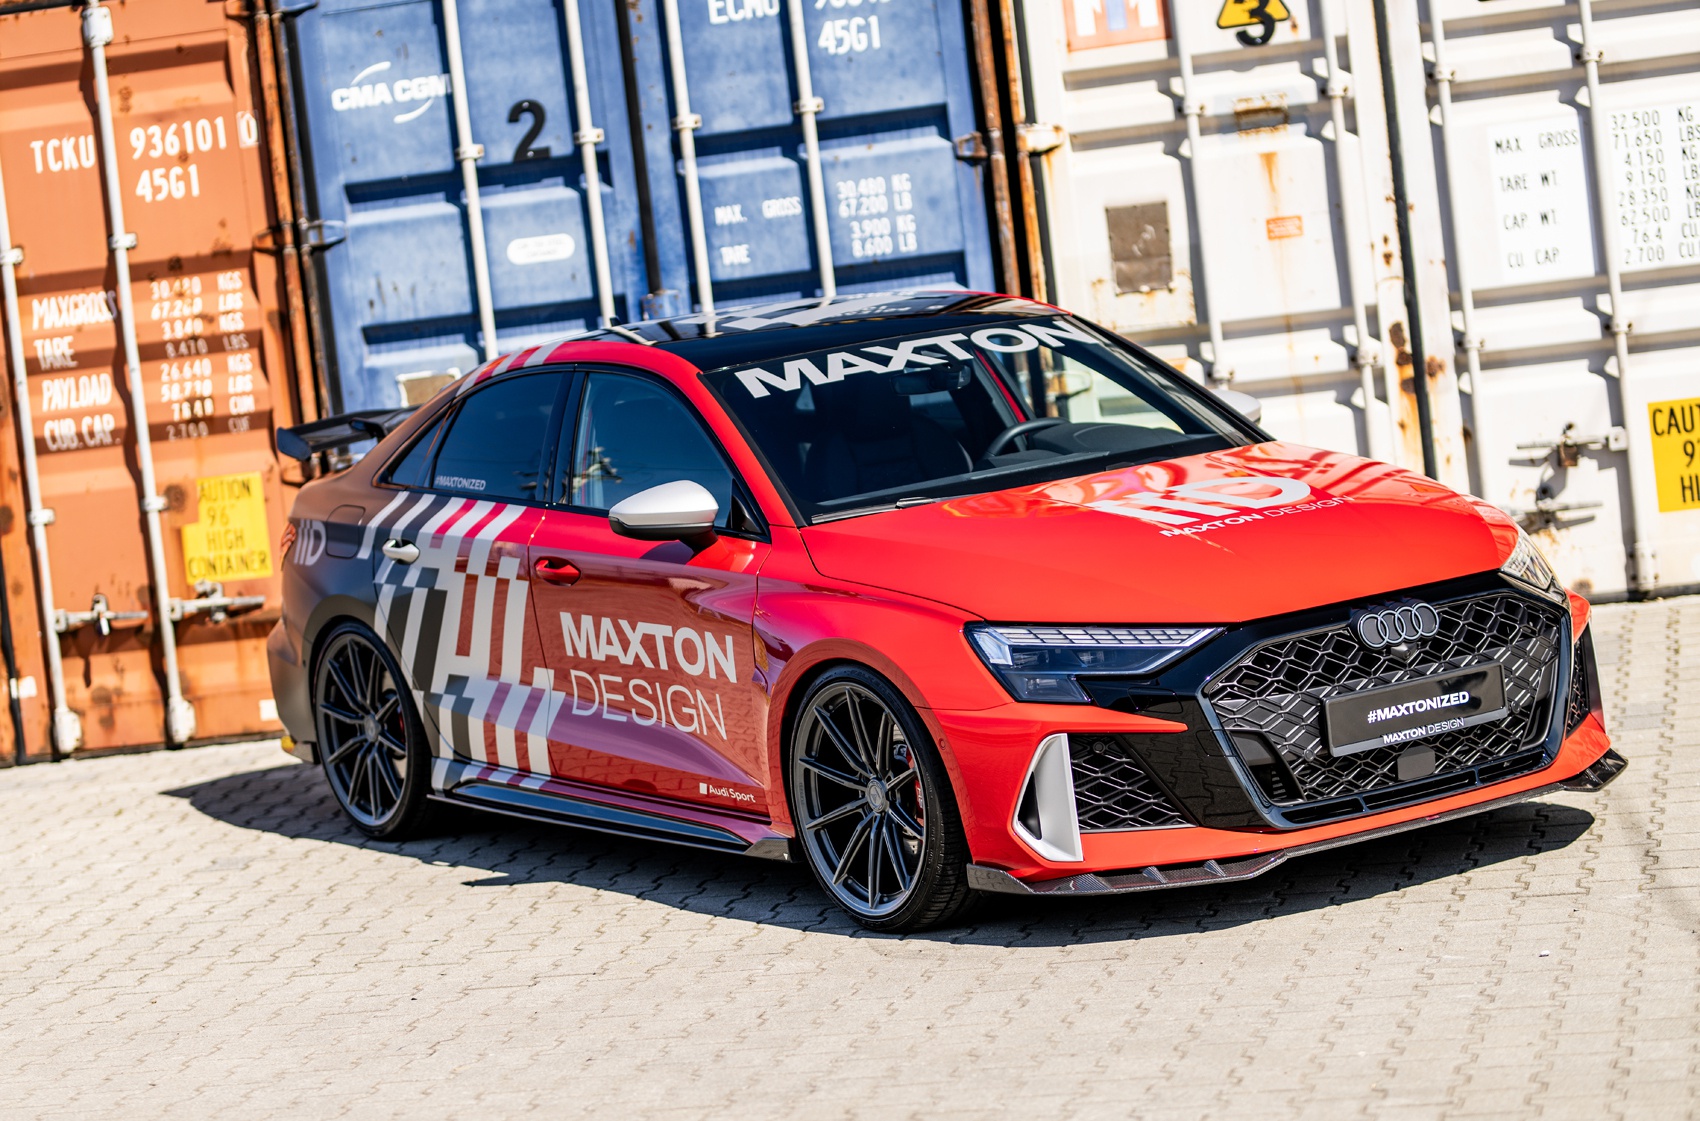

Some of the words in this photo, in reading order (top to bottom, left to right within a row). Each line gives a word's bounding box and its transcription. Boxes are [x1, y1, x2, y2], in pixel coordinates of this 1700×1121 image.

[818, 15, 881, 55] 45G1
[331, 82, 393, 112] CMA
[1677, 106, 1694, 123] KG
[507, 99, 550, 162] 2
[1494, 137, 1523, 154] MAX
[1538, 129, 1580, 149] GROSS
[30, 135, 96, 174] TCKU
[130, 116, 227, 160] 936101
[1682, 144, 1698, 161] KG
[891, 173, 911, 192] KG
[1500, 174, 1529, 192] TARE
[1540, 170, 1558, 188] WT
[1683, 163, 1700, 181] LB
[136, 164, 201, 203] 45G1
[762, 196, 802, 219] GROSS
[893, 192, 913, 211] LB
[896, 214, 916, 233] KG
[1503, 213, 1528, 231] CAP
[1540, 209, 1557, 226] WT
[898, 233, 918, 252] LB
[1508, 252, 1525, 268] CU
[1535, 247, 1560, 265] CAP
[217, 271, 243, 291] KGS
[218, 292, 243, 312] LBS
[219, 311, 245, 333] KGS
[33, 336, 78, 371] TARE
[222, 333, 249, 352] LBS
[227, 353, 253, 374] KGS
[734, 320, 1100, 398] MAXTON
[42, 373, 112, 412] PAYLOAD
[228, 374, 253, 394] LBS
[1652, 403, 1700, 437] CAU
[199, 478, 252, 500] AUTION
[435, 475, 487, 491] #MAXTONIZED
[1159, 513, 1265, 537] MAXTON
[1263, 494, 1355, 517] DESIGN
[206, 529, 245, 552] HIGH
[188, 552, 268, 578] CONTAINER
[559, 611, 737, 684] MAXTON
[570, 669, 728, 741] DESIGN
[1367, 691, 1470, 724] #MAXTONIZED
[1383, 727, 1427, 744] MAXTON
[1427, 718, 1465, 734] DESIGN
[709, 784, 730, 797] Audi
[729, 788, 756, 803] Sport
